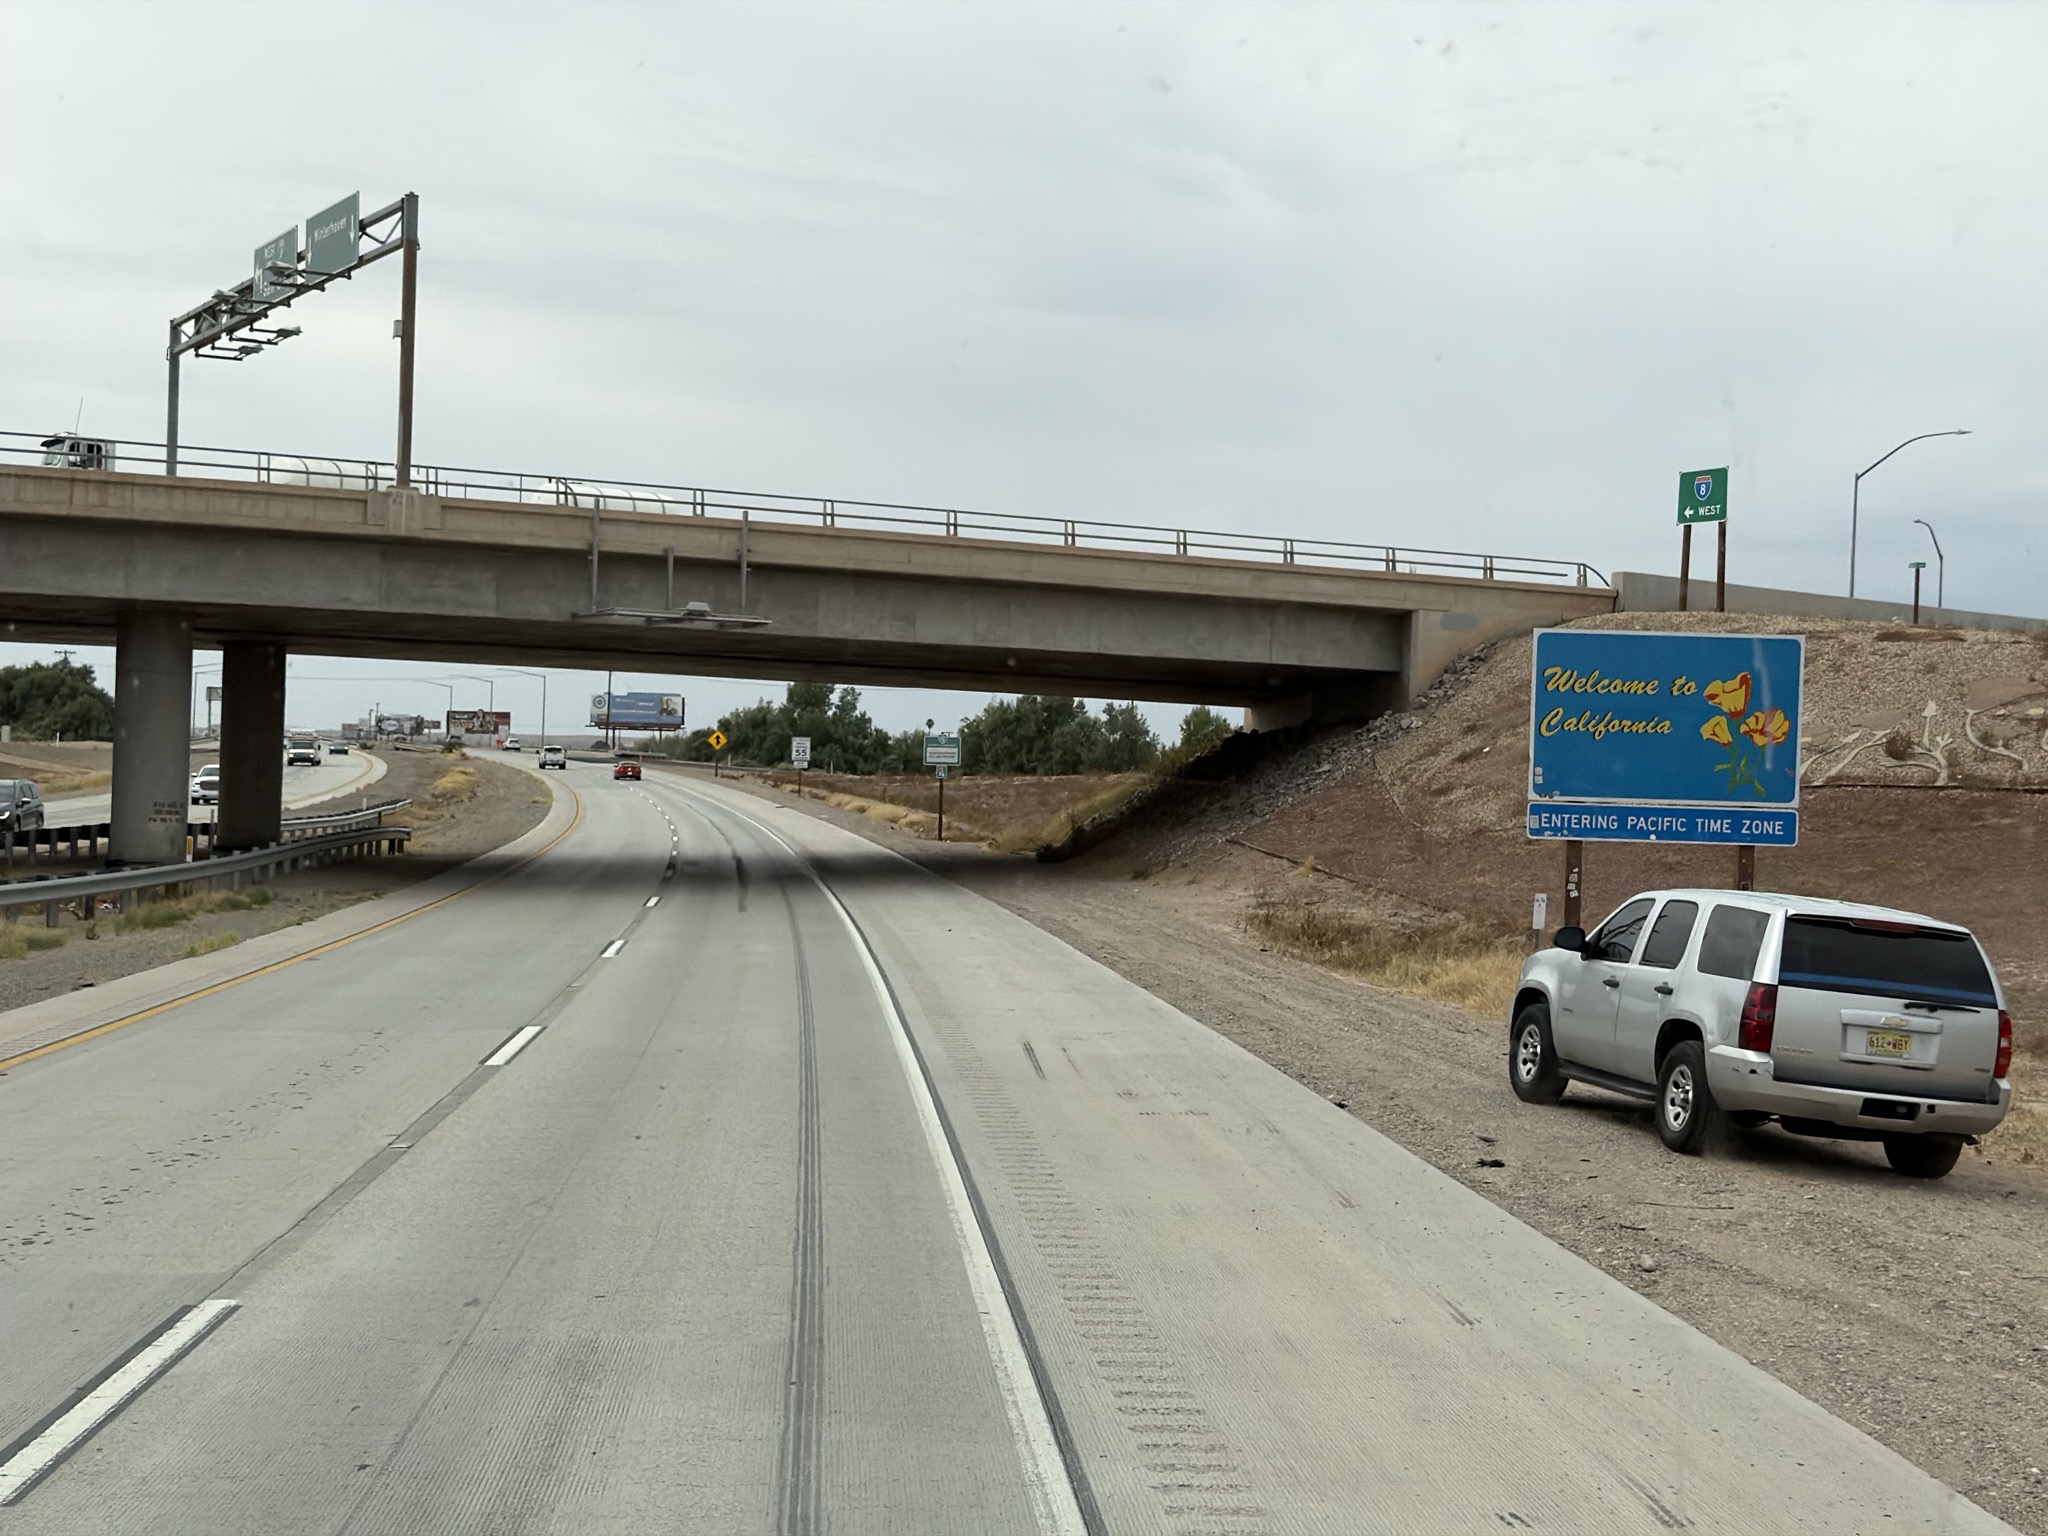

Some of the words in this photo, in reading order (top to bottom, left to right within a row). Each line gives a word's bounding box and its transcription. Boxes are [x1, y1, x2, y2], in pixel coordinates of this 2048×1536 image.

[1700, 484, 1706, 496] 8
[1698, 504, 1721, 516] WEST
[1543, 666, 1659, 695] Welcome
[1671, 675, 1698, 696] to
[1539, 707, 1673, 740] California
[795, 749, 807, 757] 55
[1541, 813, 1618, 830] ENTERING
[1627, 816, 1687, 832] PACIFIC
[1695, 818, 1732, 834] TIME
[1741, 819, 1784, 835] ZONE
